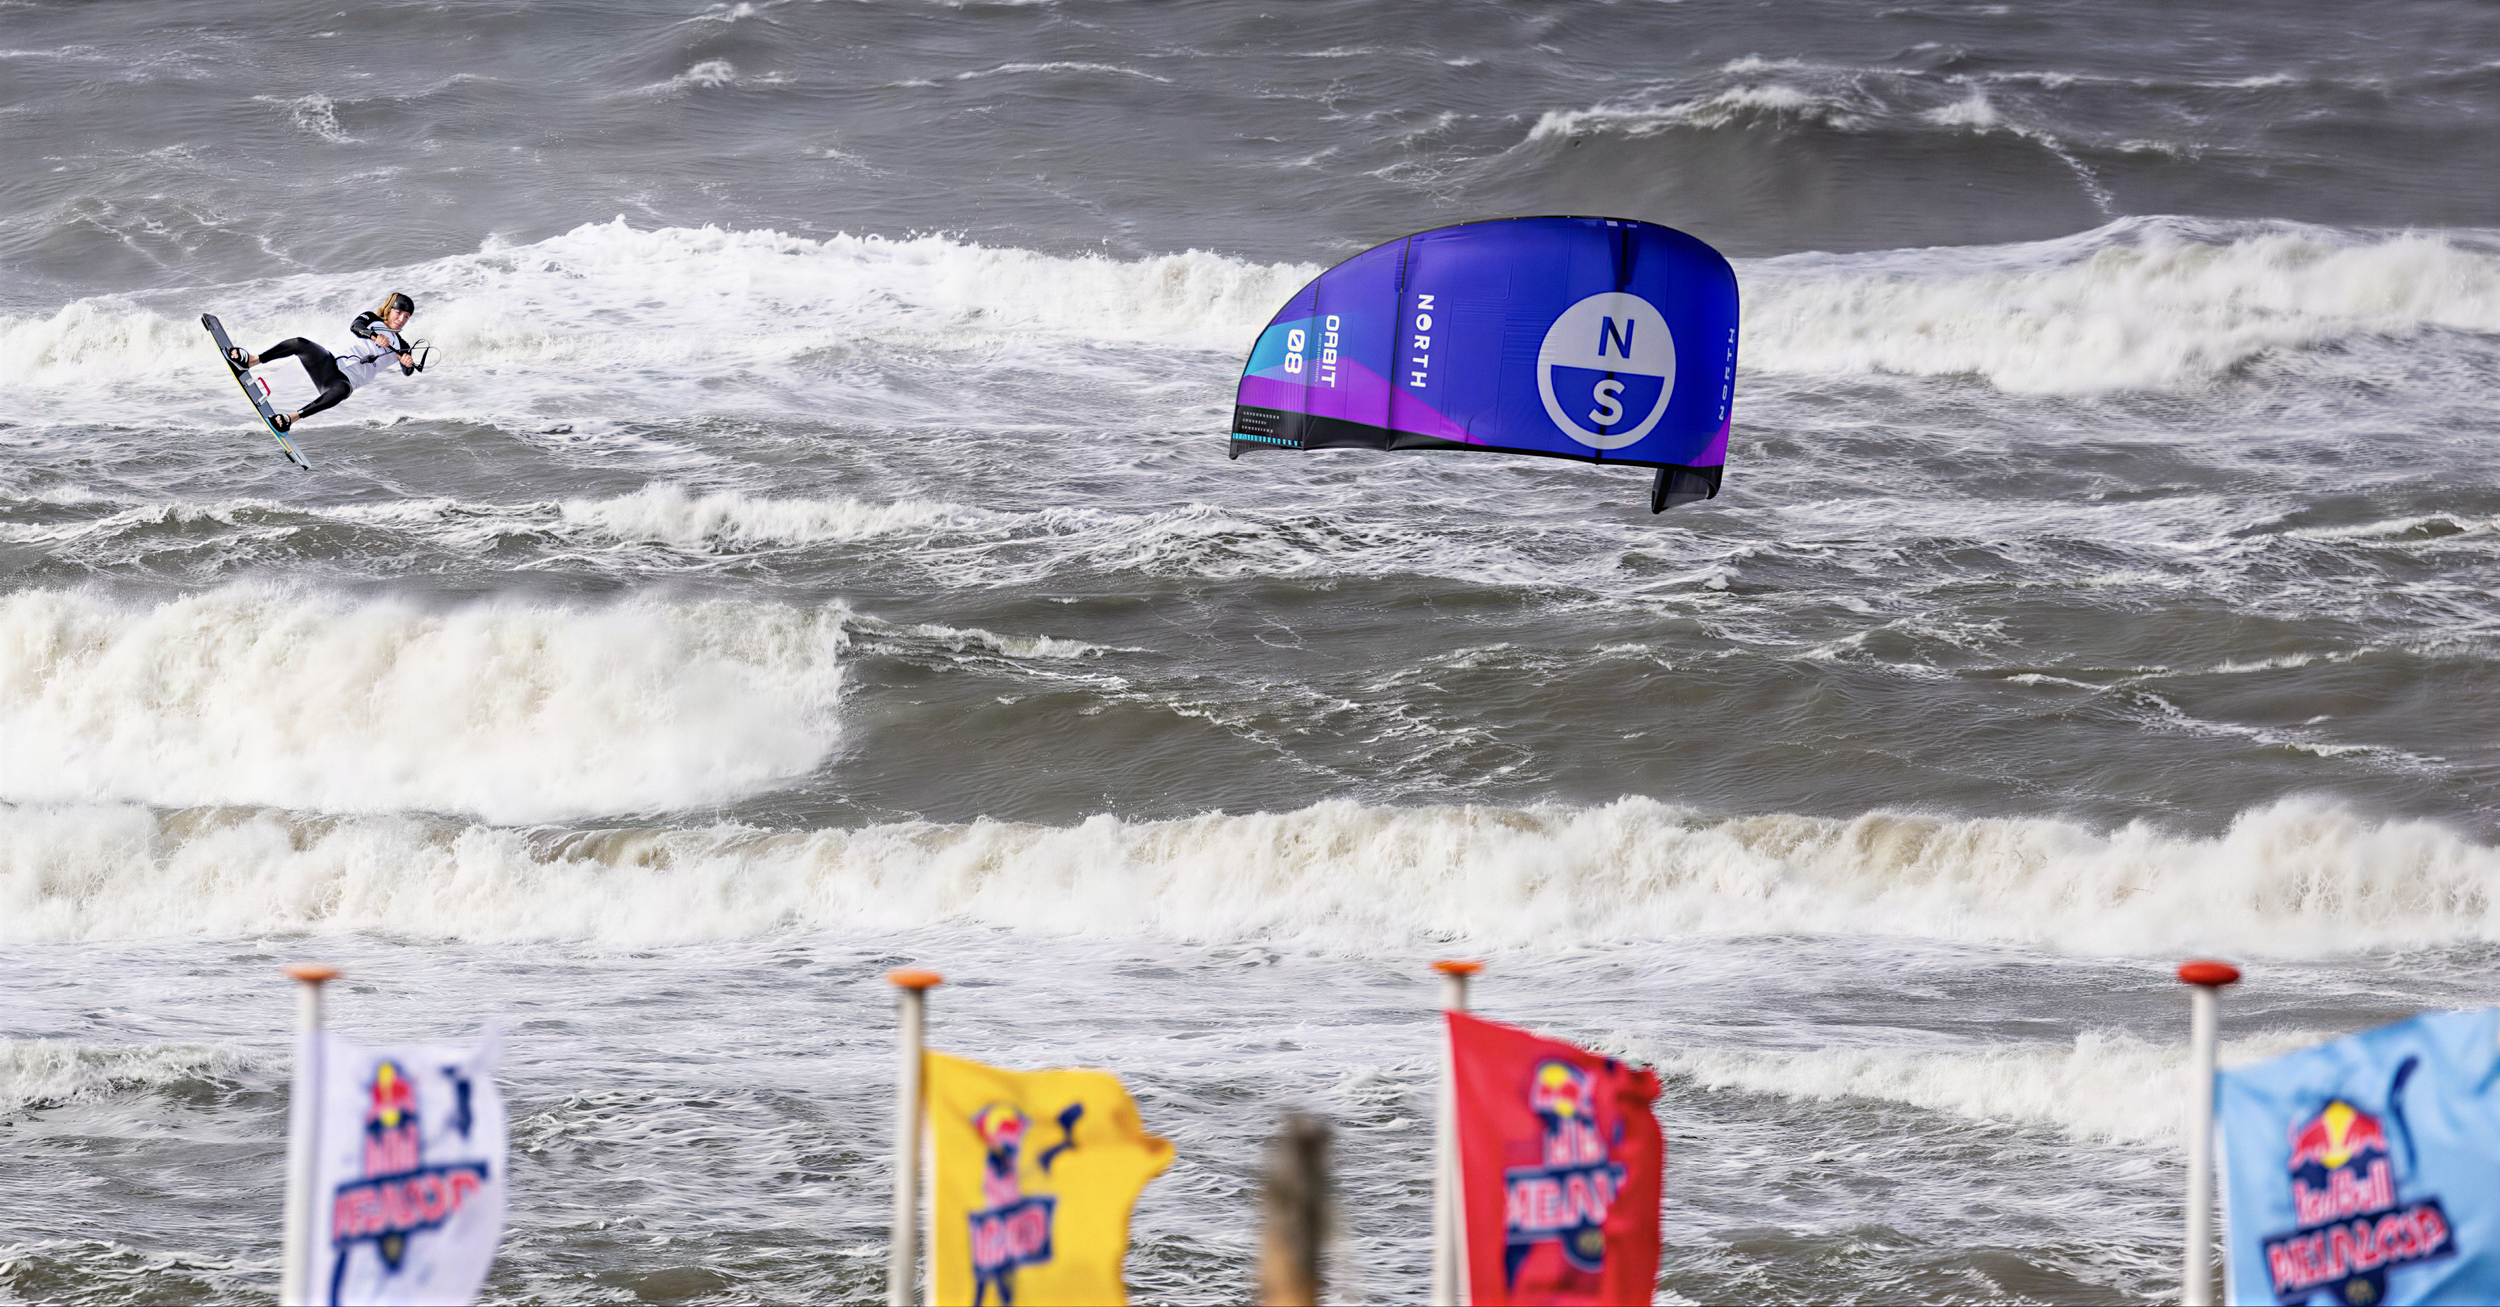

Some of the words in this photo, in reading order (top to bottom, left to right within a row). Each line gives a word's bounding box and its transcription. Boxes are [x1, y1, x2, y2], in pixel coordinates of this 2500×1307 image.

[1284, 329, 1305, 374] 08
[1321, 315, 1340, 388] ORBIT
[1410, 294, 1435, 388] NORTH
[1598, 316, 1635, 359] N
[1588, 378, 1626, 426] S
[1718, 328, 1735, 421] NORTH
